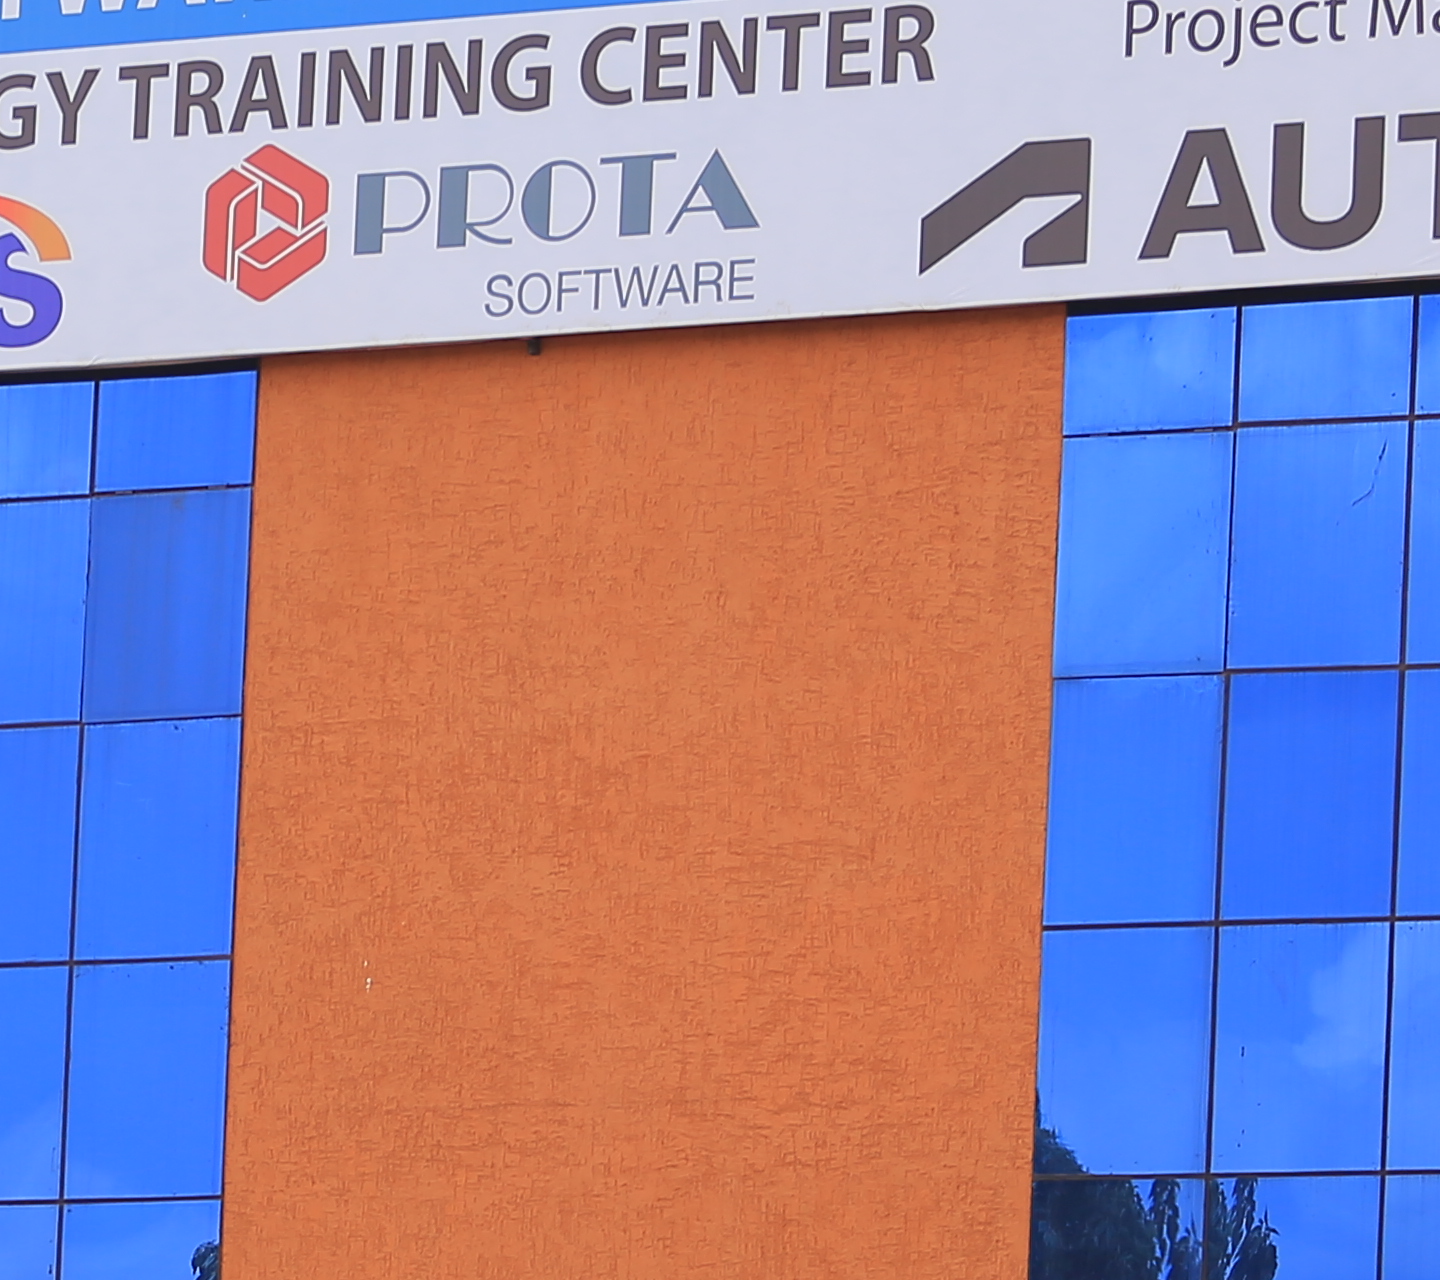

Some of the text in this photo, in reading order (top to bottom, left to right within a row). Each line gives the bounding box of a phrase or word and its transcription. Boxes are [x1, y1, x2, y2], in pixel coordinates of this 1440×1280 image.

[118, 33, 552, 141] TRAINING
[579, 3, 935, 107] CENTER
[353, 148, 761, 256] PROTA
[484, 258, 756, 318] SOFTWARE
